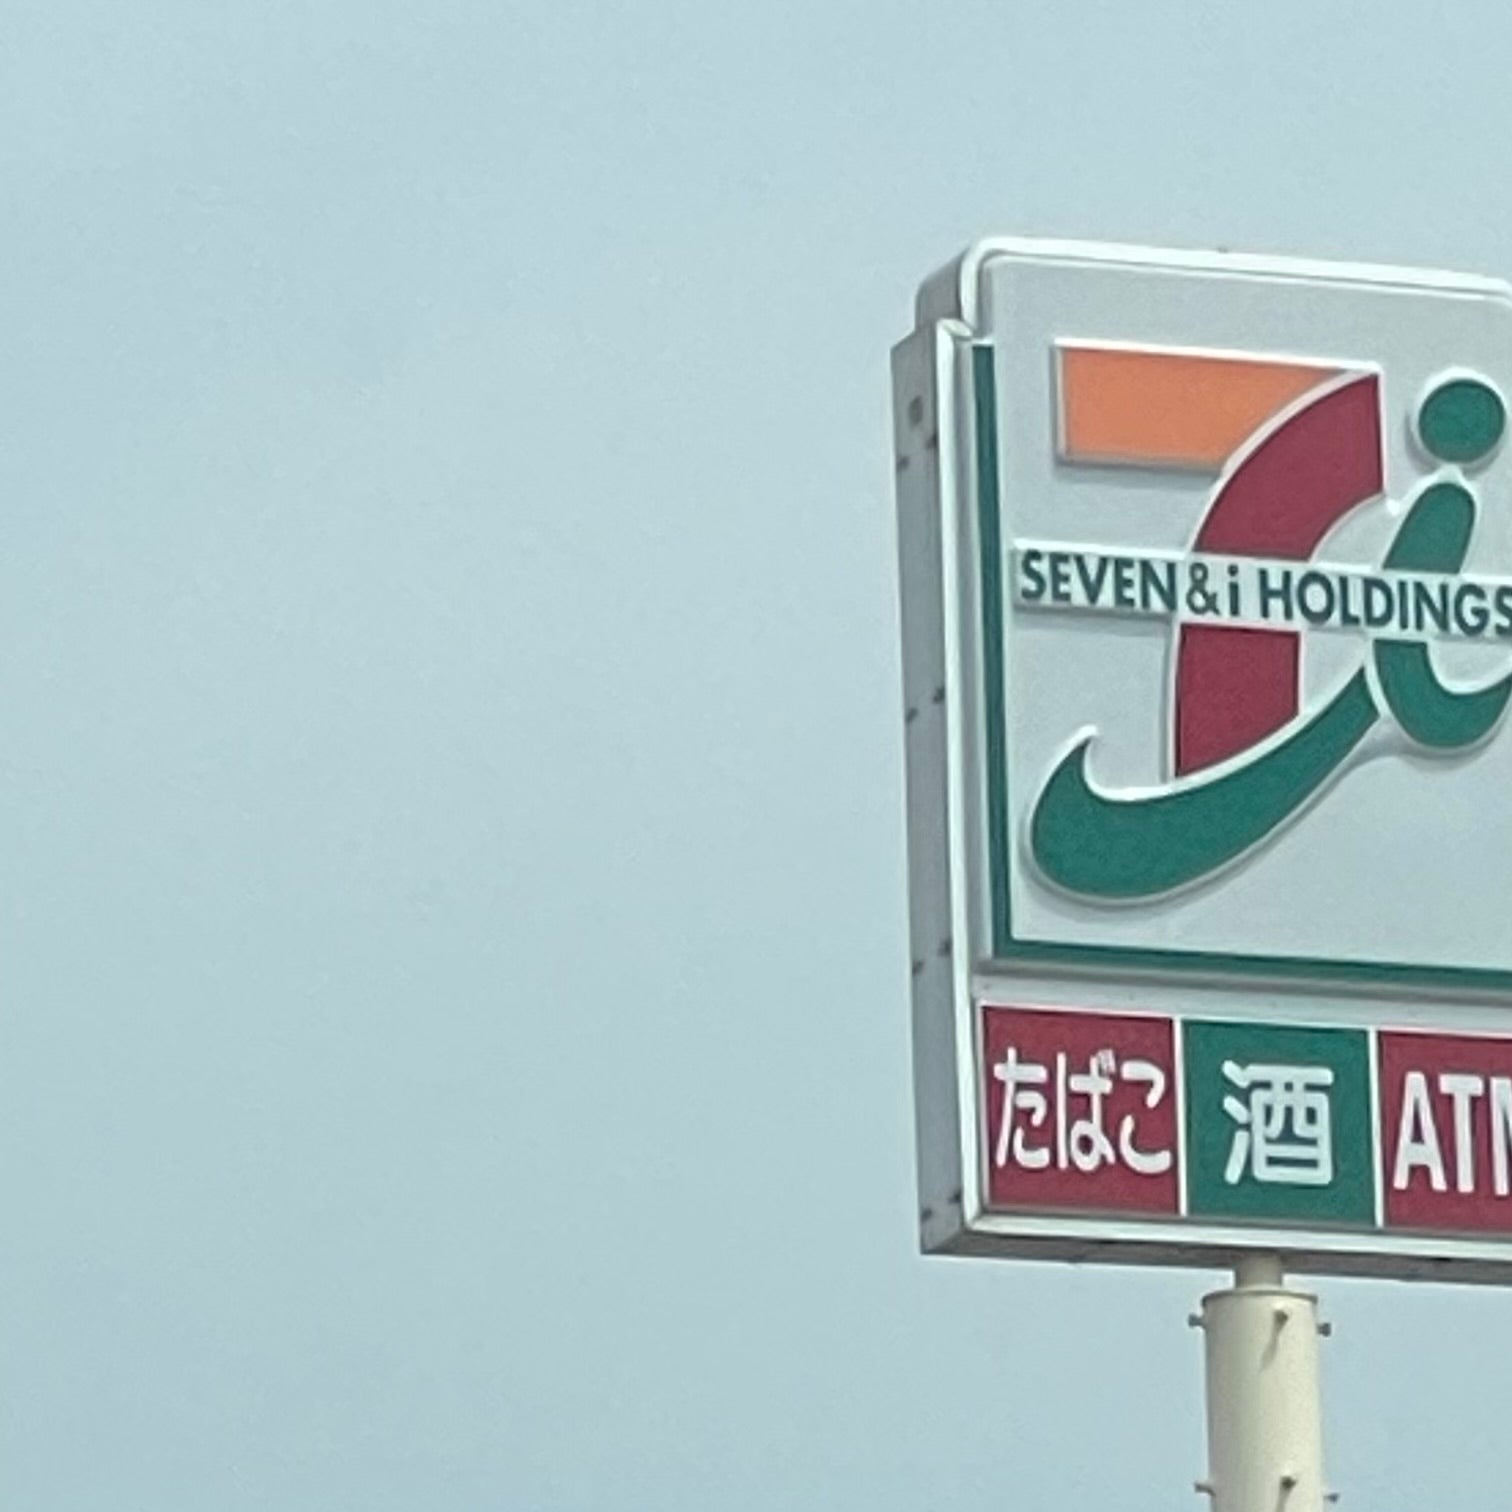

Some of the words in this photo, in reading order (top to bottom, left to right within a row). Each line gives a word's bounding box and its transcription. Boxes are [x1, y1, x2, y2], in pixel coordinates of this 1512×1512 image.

[993, 1047, 1171, 1174] たばこ
[1222, 1060, 1334, 1184] 酒
